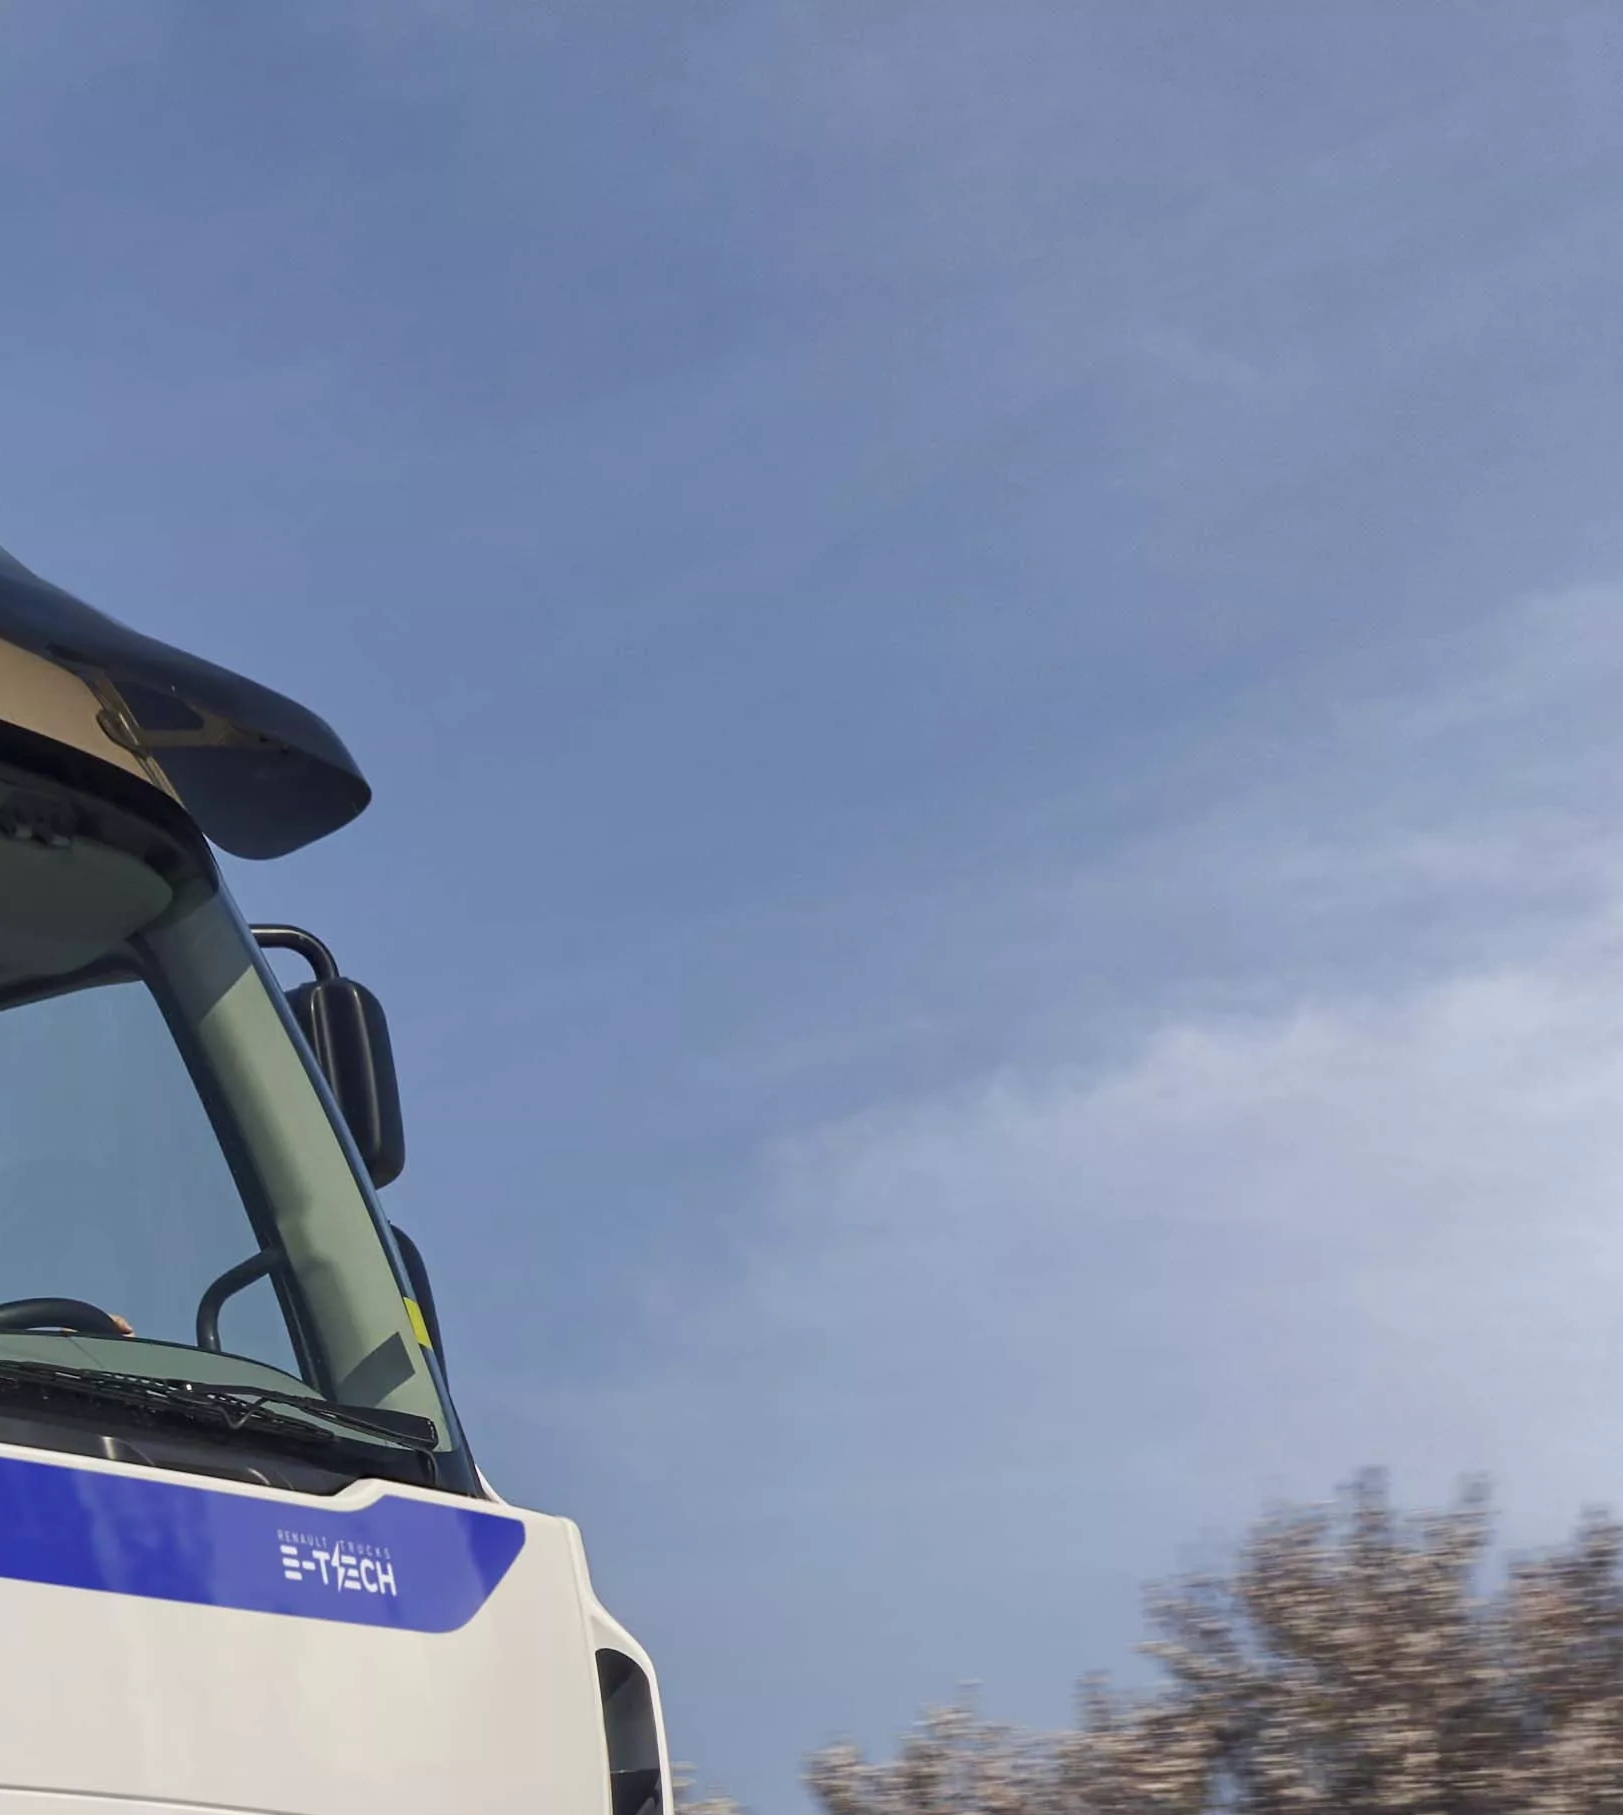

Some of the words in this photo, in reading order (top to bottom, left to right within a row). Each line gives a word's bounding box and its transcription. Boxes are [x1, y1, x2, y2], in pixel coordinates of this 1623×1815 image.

[276, 1528, 328, 1549] RENAULT
[339, 1540, 391, 1560] TRUCKS
[280, 1544, 397, 1597] E-TECH
